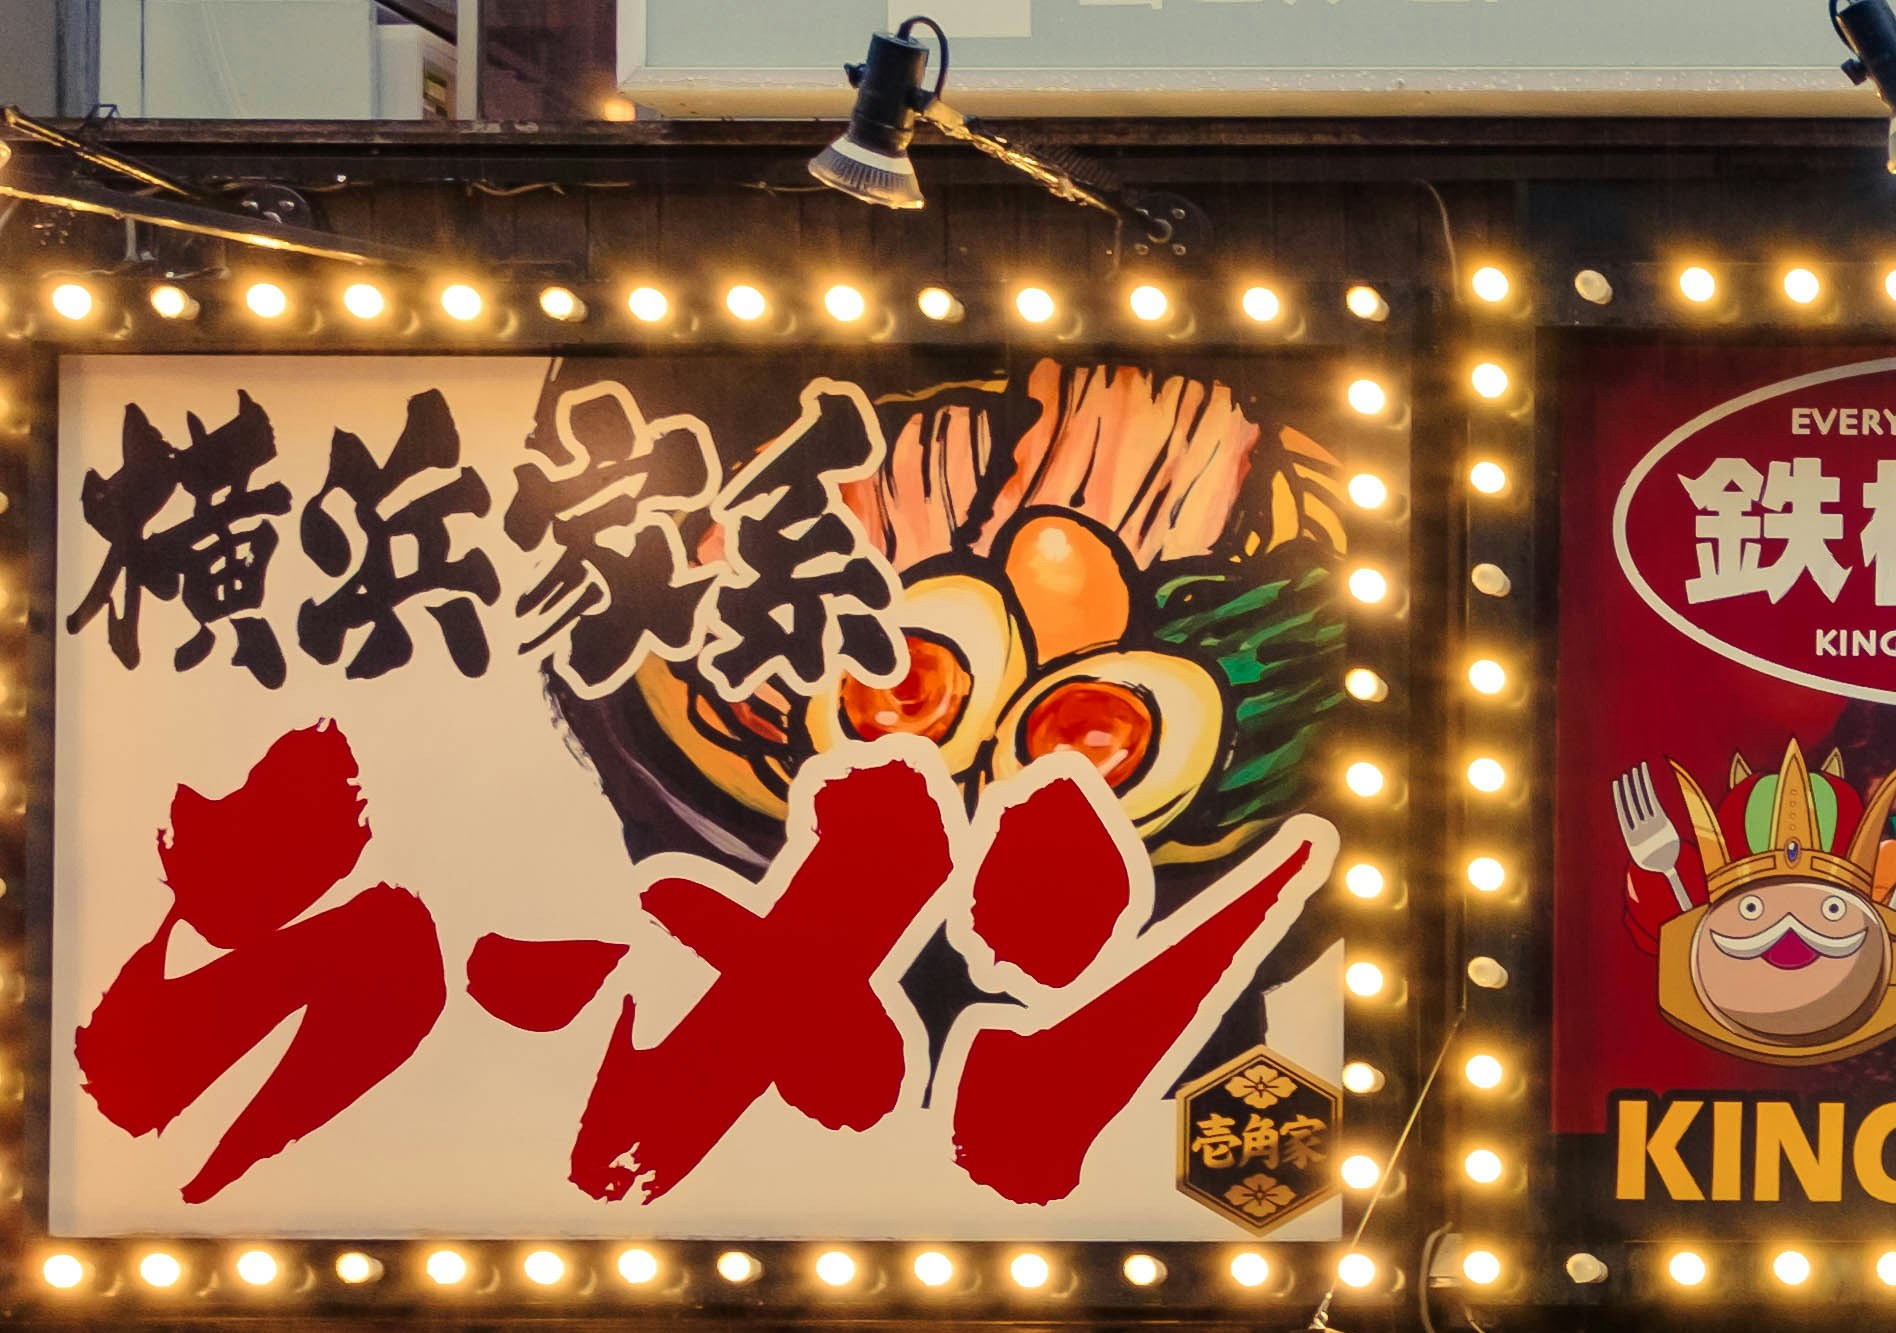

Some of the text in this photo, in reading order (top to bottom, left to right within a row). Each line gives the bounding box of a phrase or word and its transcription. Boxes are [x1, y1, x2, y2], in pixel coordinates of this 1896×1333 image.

[68, 388, 912, 695] 横浜家系
[75, 716, 1320, 1206] ラーメン
[1190, 1110, 1330, 1172] 壱角家
